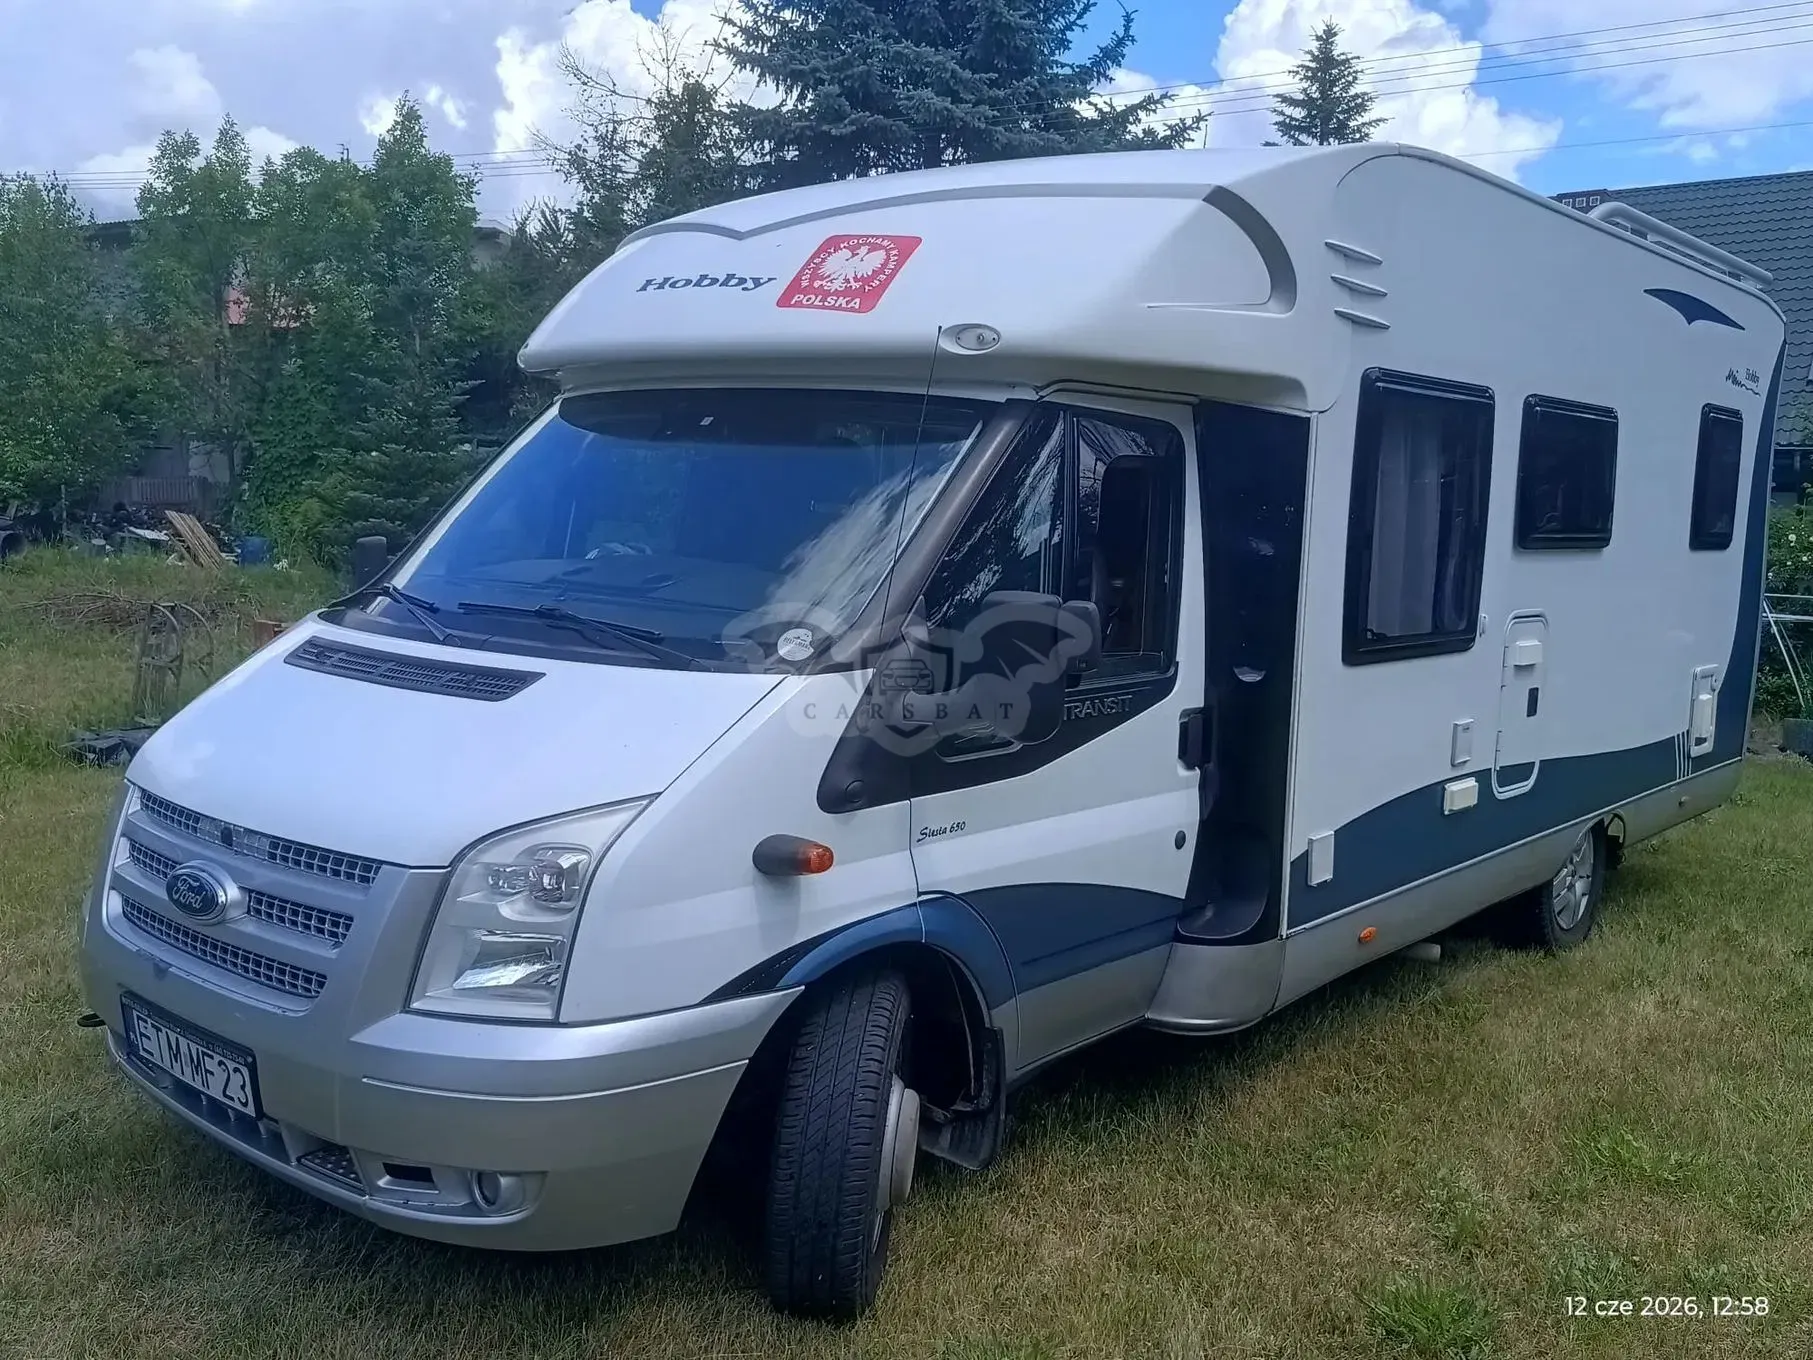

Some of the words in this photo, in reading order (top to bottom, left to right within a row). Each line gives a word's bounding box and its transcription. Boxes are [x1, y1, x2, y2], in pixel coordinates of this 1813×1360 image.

[840, 237, 896, 250] KOCHAMY
[864, 248, 900, 293] KAMPERY
[636, 273, 777, 292] Hobby
[790, 294, 861, 309] POLSKA
[1063, 695, 1133, 720] TRANSIT
[916, 826, 948, 843] Siesta
[949, 821, 966, 834] 650
[172, 875, 206, 909] Ford
